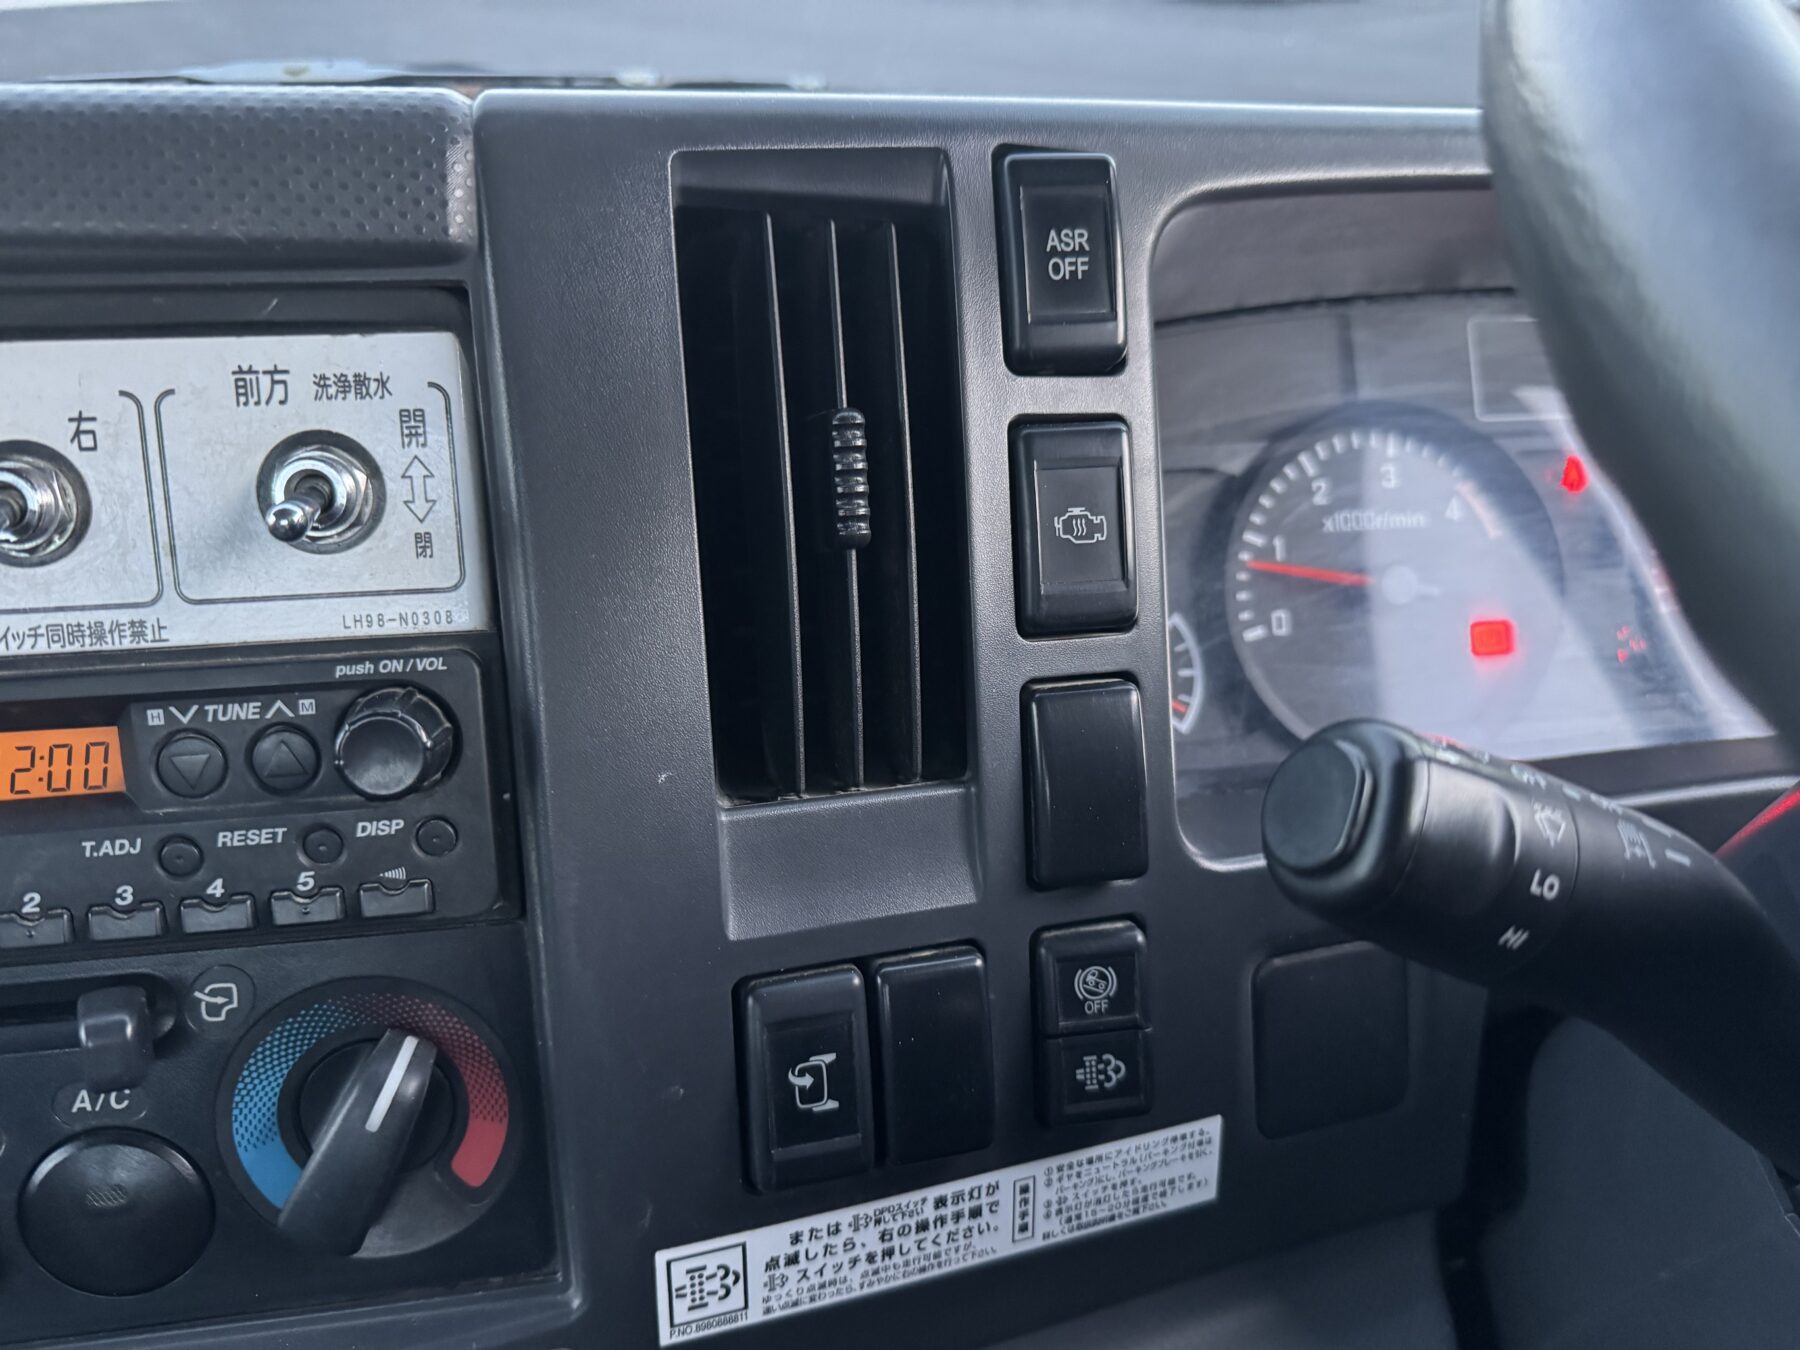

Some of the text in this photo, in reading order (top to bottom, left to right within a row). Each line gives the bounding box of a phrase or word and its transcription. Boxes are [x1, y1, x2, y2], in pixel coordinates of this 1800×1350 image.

[1046, 229, 1090, 252] ASR
[1048, 256, 1089, 280] OFF
[231, 364, 392, 407] 前方 洗浄散水
[68, 410, 98, 452] 右
[399, 408, 428, 449] 開
[1379, 463, 1398, 489] 3
[1311, 477, 1329, 505] 2
[1445, 496, 1461, 520] 4
[414, 531, 434, 559] 閉
[1273, 535, 1286, 561] 1
[343, 610, 453, 629] LH98-N0308
[1271, 609, 1291, 637] 0
[335, 661, 375, 678] push
[204, 702, 262, 722] TUNE
[10, 742, 109, 794] 2:00
[217, 828, 287, 848] RESET
[355, 820, 405, 839] DISP
[81, 838, 142, 859] T.ADJ
[206, 878, 225, 899] 4
[296, 872, 316, 892] 5
[1530, 868, 1560, 900] LO
[22, 893, 42, 914] 2
[115, 886, 134, 906] 3
[1084, 999, 1109, 1014] OFF
[71, 1089, 131, 1113] A/C
[932, 1179, 999, 1211] 表示灯が
[788, 1219, 842, 1247] または
